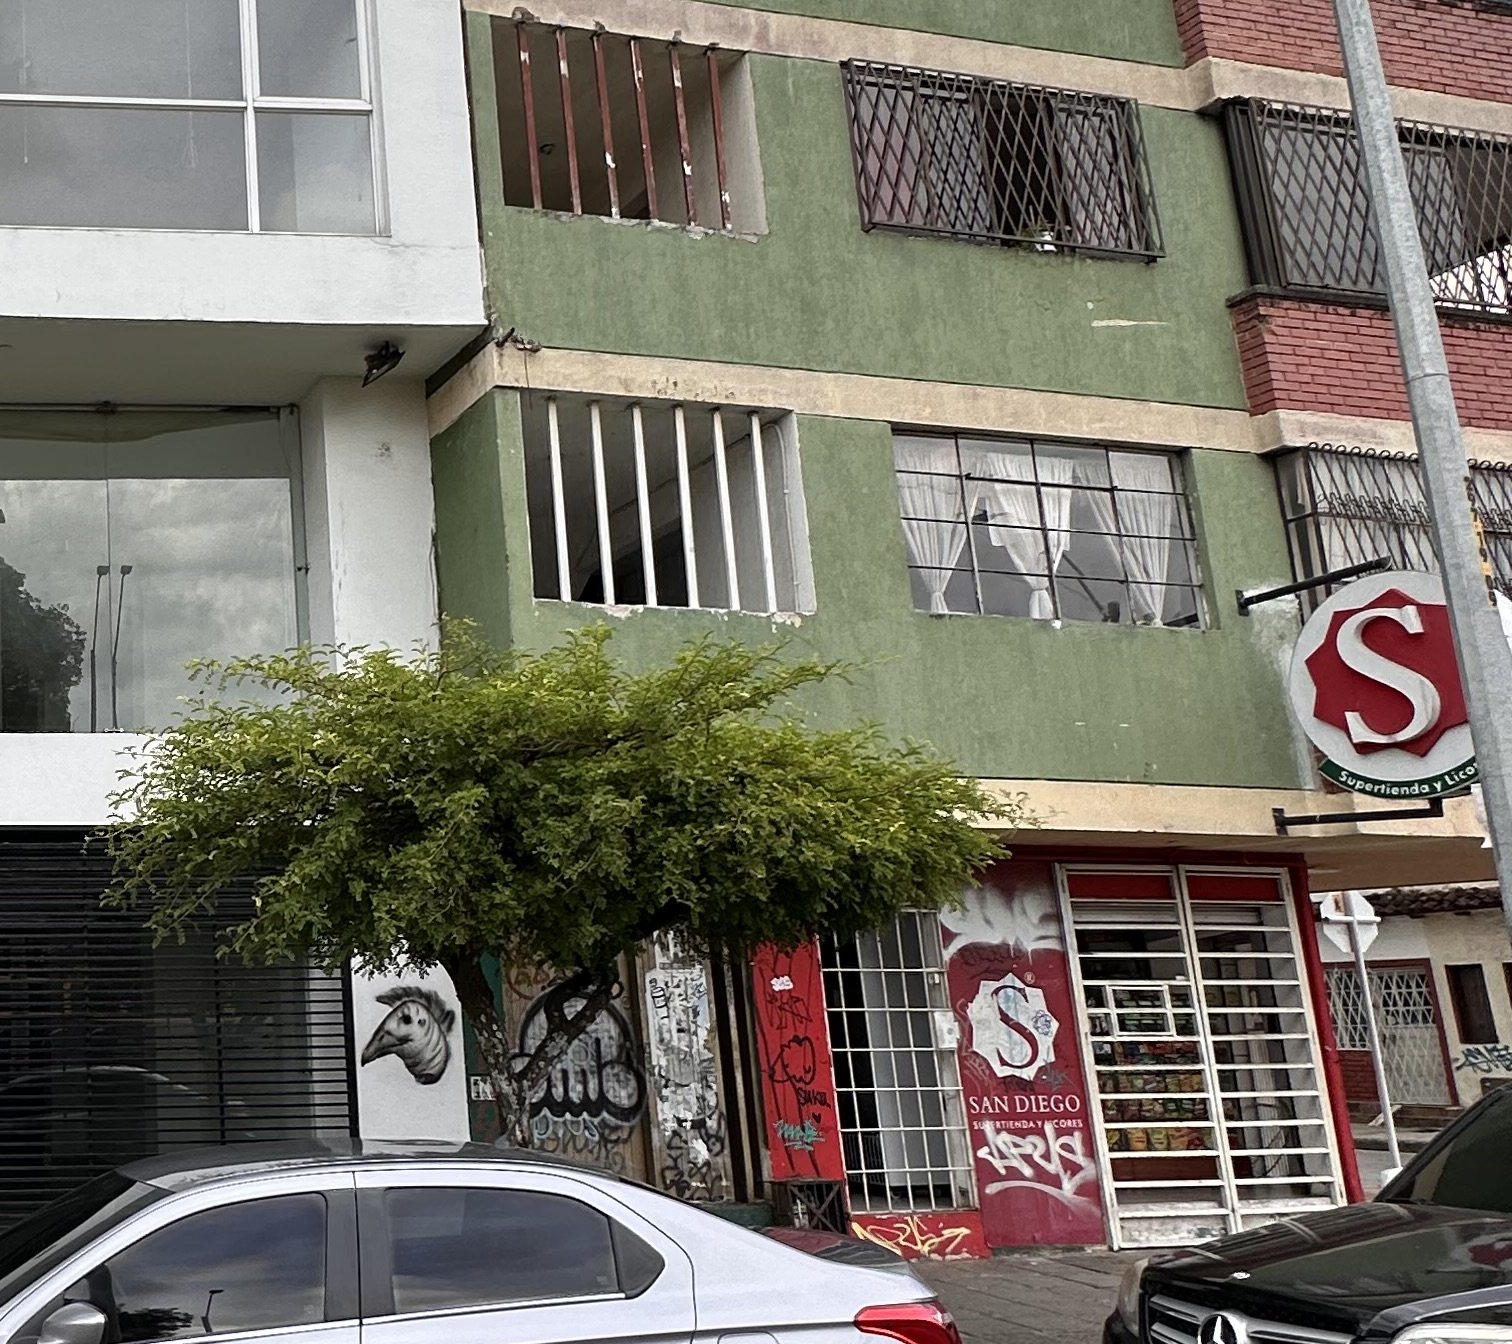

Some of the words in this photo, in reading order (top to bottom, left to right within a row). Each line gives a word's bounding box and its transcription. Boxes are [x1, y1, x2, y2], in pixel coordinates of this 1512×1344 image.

[1336, 605, 1441, 744] S
[1338, 769, 1430, 796] Supertienda
[1432, 780, 1443, 793] y
[991, 985, 1040, 1070] S
[969, 1096, 1009, 1114] SAN
[1015, 1095, 1081, 1113] DIEGO
[972, 1120, 1035, 1130] SUERTIENDA
[1045, 1119, 1083, 1129] CORES
